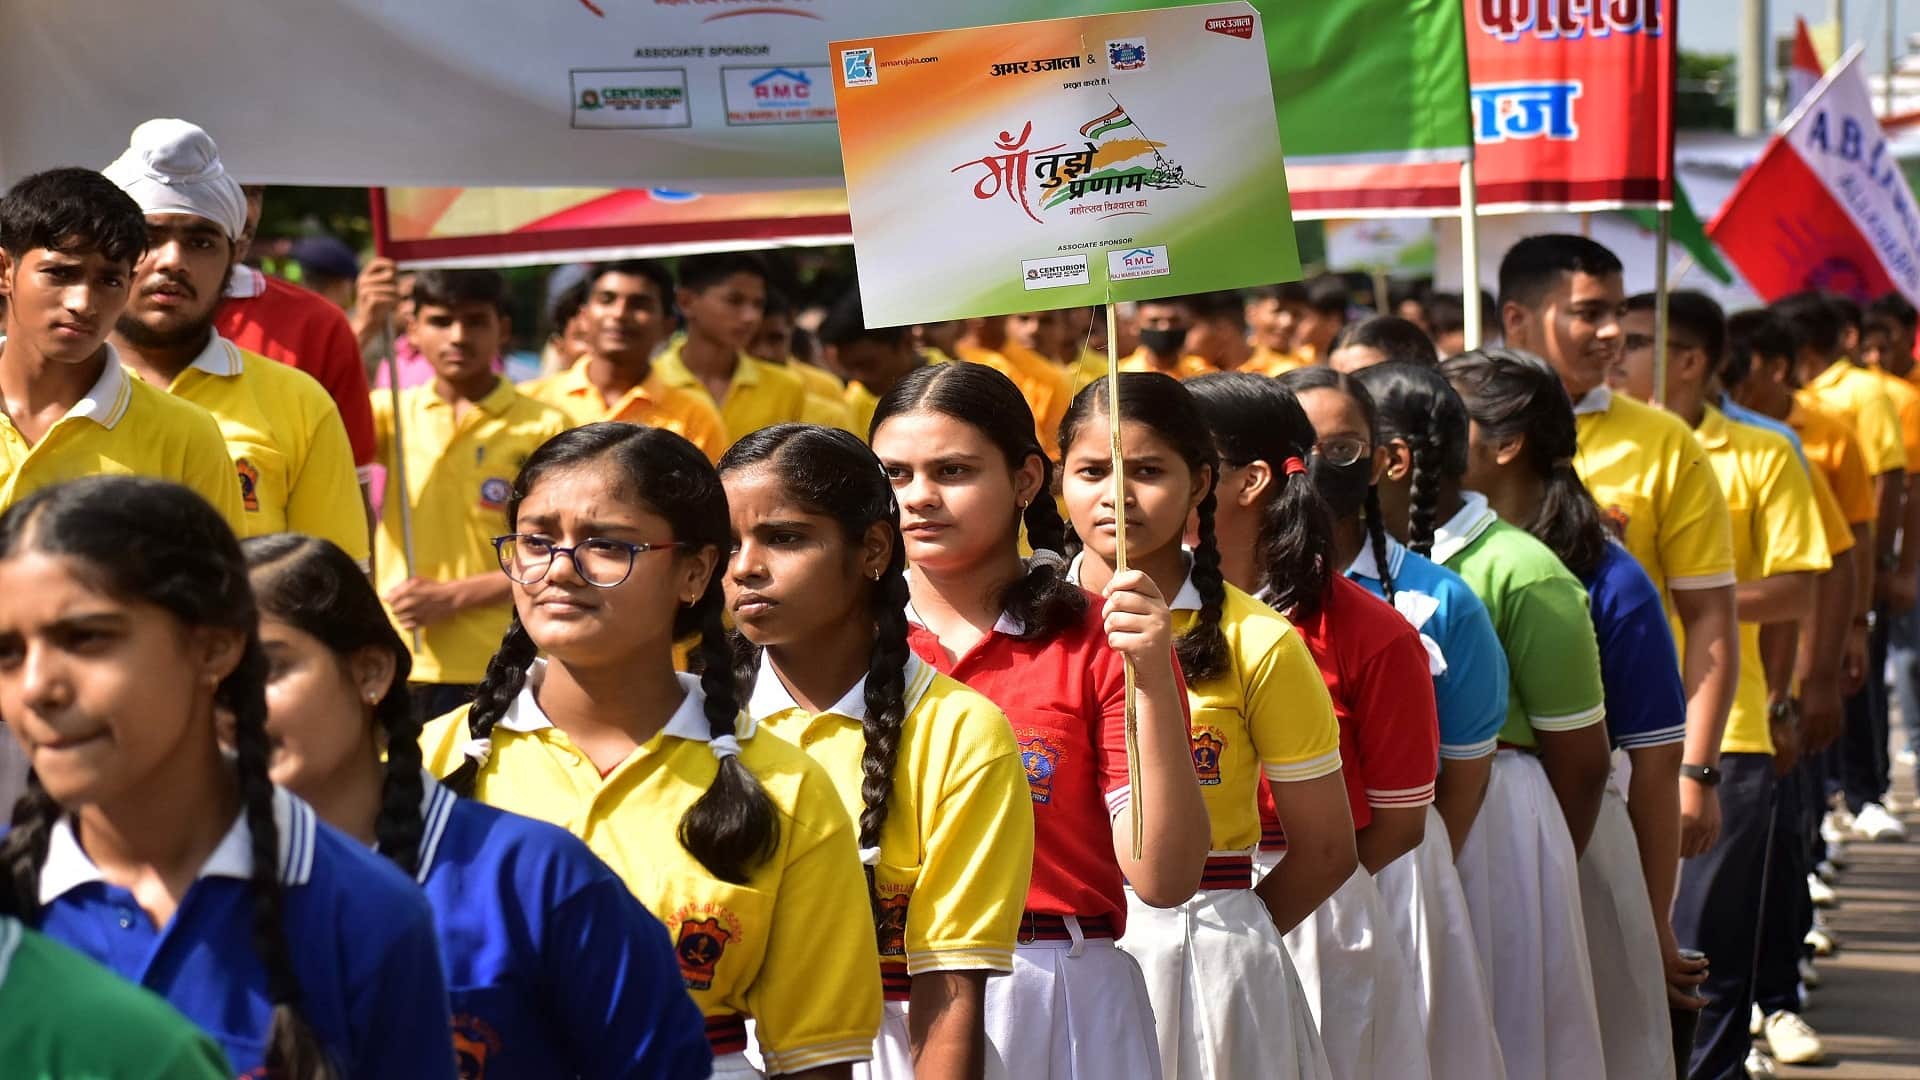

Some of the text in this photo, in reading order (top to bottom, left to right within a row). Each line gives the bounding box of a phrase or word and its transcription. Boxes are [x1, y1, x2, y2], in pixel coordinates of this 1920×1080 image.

[634, 45, 770, 58] ASSOCIATE SPONSOR
[880, 56, 939, 68] amarujala.com
[990, 54, 1096, 76] अमर उजाला &
[602, 87, 682, 99] CENTURION
[951, 120, 1067, 224] माँ
[1034, 142, 1099, 188] तुझे
[1068, 173, 1146, 200] प्रणाम
[1069, 198, 1148, 215] महोत्सव विश्वास का
[1057, 237, 1133, 251] ASSOCIATE SPONSOR
[1039, 263, 1086, 274] CENTURION
